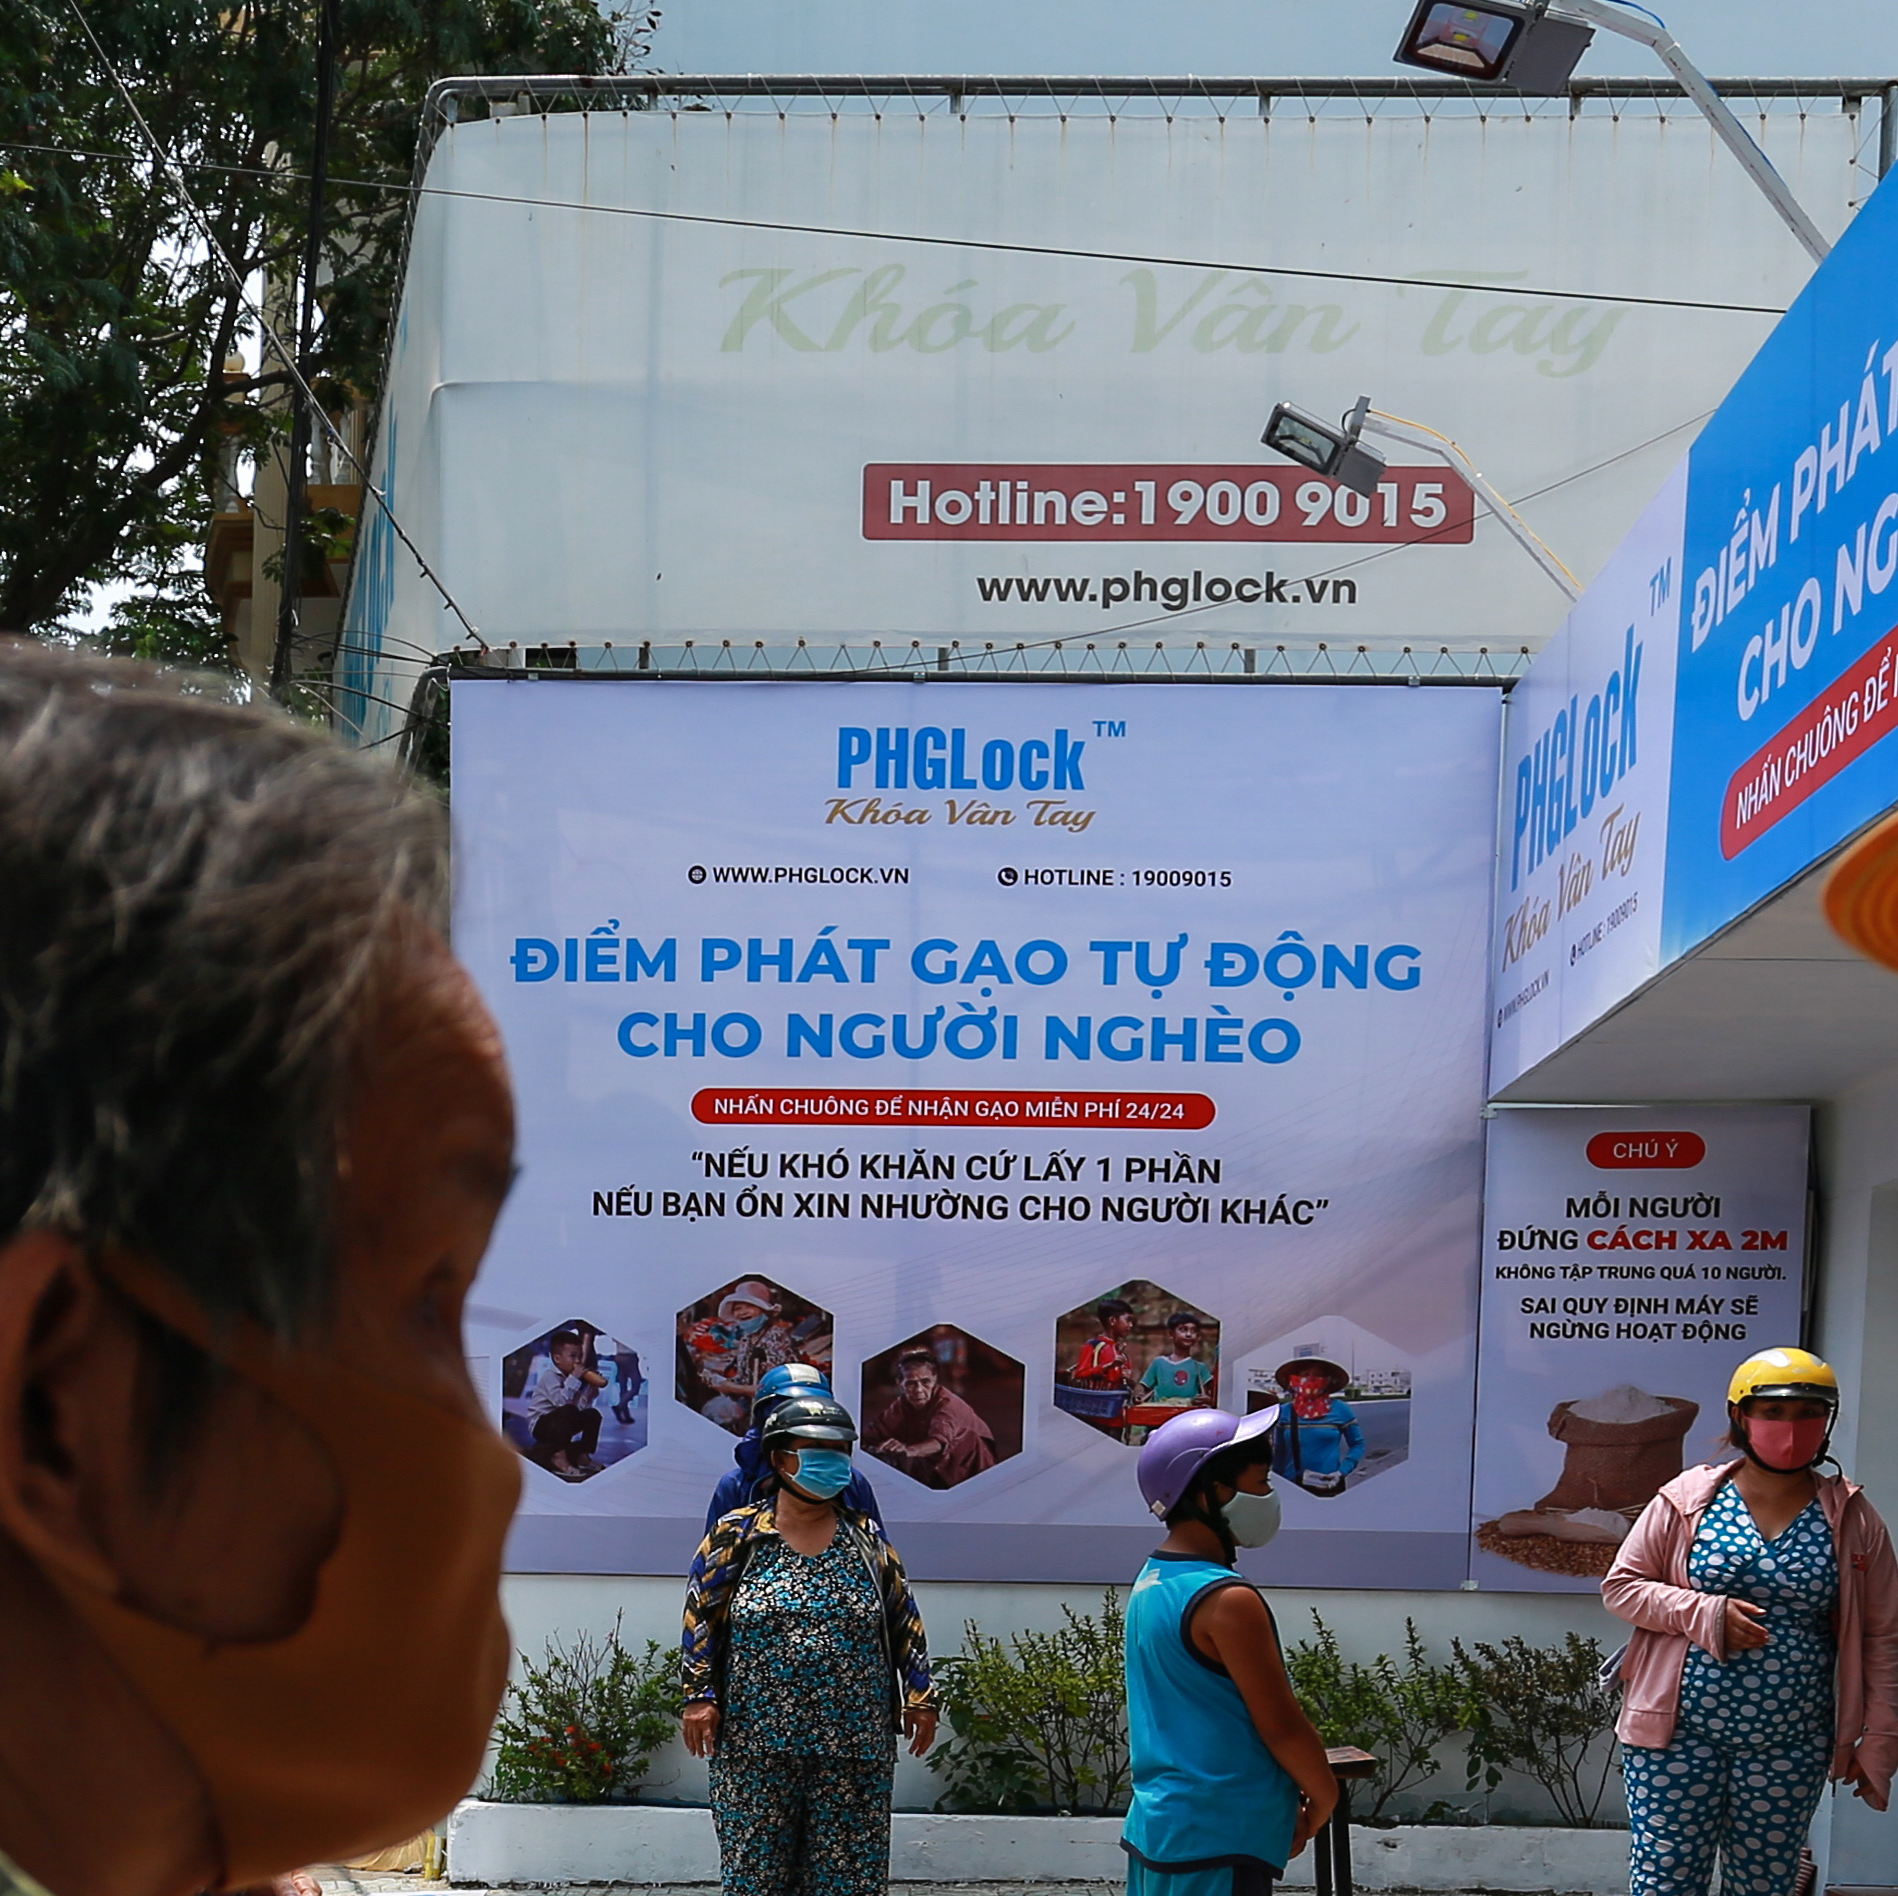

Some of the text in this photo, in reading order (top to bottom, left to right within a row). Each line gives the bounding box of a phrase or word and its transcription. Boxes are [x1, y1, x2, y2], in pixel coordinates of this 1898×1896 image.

[717, 264, 1633, 379] Khóa Vân Tay
[1300, 480, 1447, 527] 9015
[976, 569, 1357, 612] www.phglock.vn
[1691, 487, 1781, 654] ĐIỂM
[1737, 577, 1821, 722] CHO
[836, 720, 1127, 791] PHGLock TM
[1510, 624, 1644, 892] PHGLock
[1735, 753, 1781, 830] NHẤN
[1783, 690, 1859, 788] CHUÔNG
[1863, 646, 1891, 723] ĐỂ
[823, 796, 1097, 833] Khóa Vân Tay
[712, 867, 910, 885] WWW.PHGLOCK.VN
[1024, 868, 1114, 887] HOTLINE
[1131, 869, 1233, 888] 19009015
[1502, 802, 1642, 973] Khóa Vân Tay
[509, 918, 1422, 1002] ĐIỂM PHÁT GẠO TỰ ĐỘNG
[617, 1001, 1302, 1064] CHO NGƯỜI NGHÈO
[714, 1093, 1185, 1121] NHẤN CHUÔNG ĐỂ NHẬN GẠO MIỄN PHÍ 24/24
[780, 1148, 850, 1180] KHÓ
[860, 1150, 955, 1180] KHĂN
[966, 1149, 1017, 1181] CỨ
[1024, 1149, 1087, 1182] LẤY
[1096, 1157, 1112, 1182] 1
[1125, 1151, 1222, 1184] PHẦN
[1613, 1138, 1680, 1159] CHÚ Ý
[592, 1184, 653, 1217] NẾU
[662, 1191, 726, 1223] BẠN
[735, 1185, 783, 1218] ỔN
[794, 1193, 850, 1219] XIN
[860, 1189, 1009, 1222] NHƯỜNG
[1018, 1196, 1091, 1223] CHO
[1101, 1192, 1210, 1224] NGƯỜI
[1565, 1191, 1721, 1219] MỖI NGƯỜI
[1497, 1225, 1788, 1251] ĐỨNG CÁCH XA 2M
[1495, 1263, 1787, 1282] KHÔNG TẬP TRUNG QUÁ 10 NGƯỜI.
[1520, 1294, 1759, 1318] SAI QUY ĐỊNH MÁY SẼ
[1529, 1320, 1747, 1344] NGỪNG HOẠT ĐỘNG
